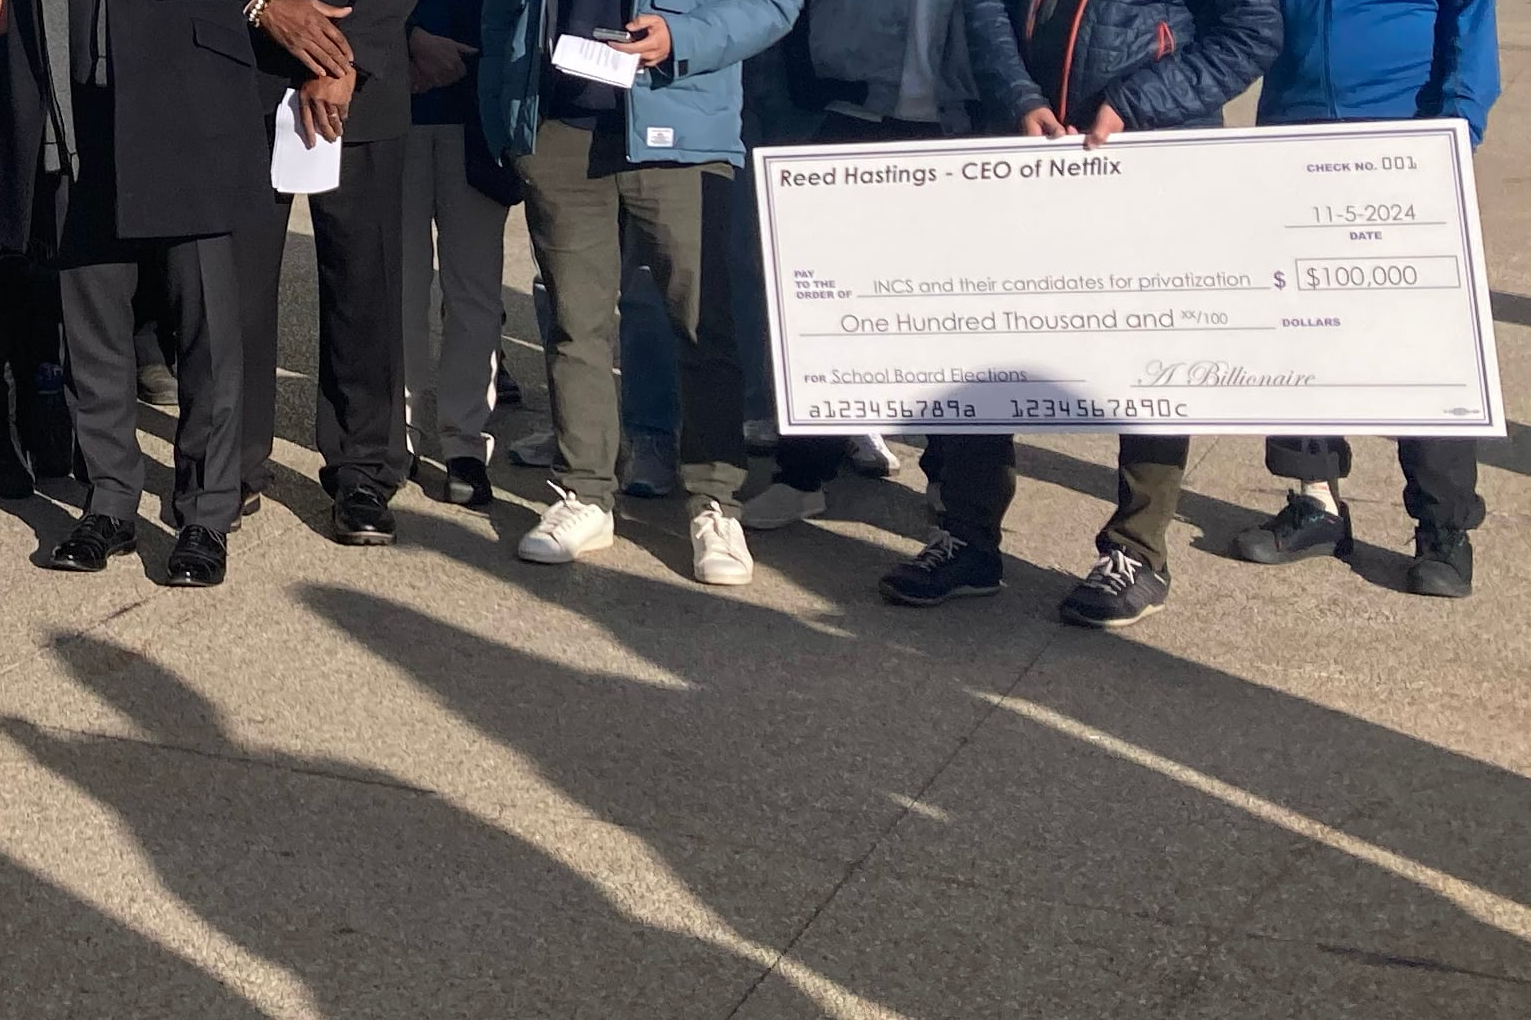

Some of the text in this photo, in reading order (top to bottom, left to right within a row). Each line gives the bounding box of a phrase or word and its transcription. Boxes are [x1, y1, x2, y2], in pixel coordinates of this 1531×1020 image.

[780, 167, 836, 187] Reed
[844, 165, 937, 186] Hastings
[961, 161, 1012, 180] CEO
[1020, 159, 1042, 178] of
[1050, 156, 1122, 177] Netflix
[1306, 156, 1417, 172] CHECK NO. 001
[1313, 204, 1416, 223] 11-5-2024
[1349, 231, 1383, 240] DATE
[793, 270, 814, 279] PAY
[873, 265, 1418, 294] INCS and their candidates for privatization $ $100,000
[796, 280, 836, 289] TO THE
[796, 290, 852, 299] ORDER OF
[841, 314, 889, 333] One
[897, 312, 996, 332] Hundred
[1002, 309, 1118, 331] Thousand
[1126, 308, 1174, 329] and
[1282, 318, 1341, 328] DOLLARS
[804, 367, 1027, 384] FOR School Board Elections
[1187, 360, 1317, 387] Billionaire
[809, 399, 1188, 418] a123456789a 1234567890c
